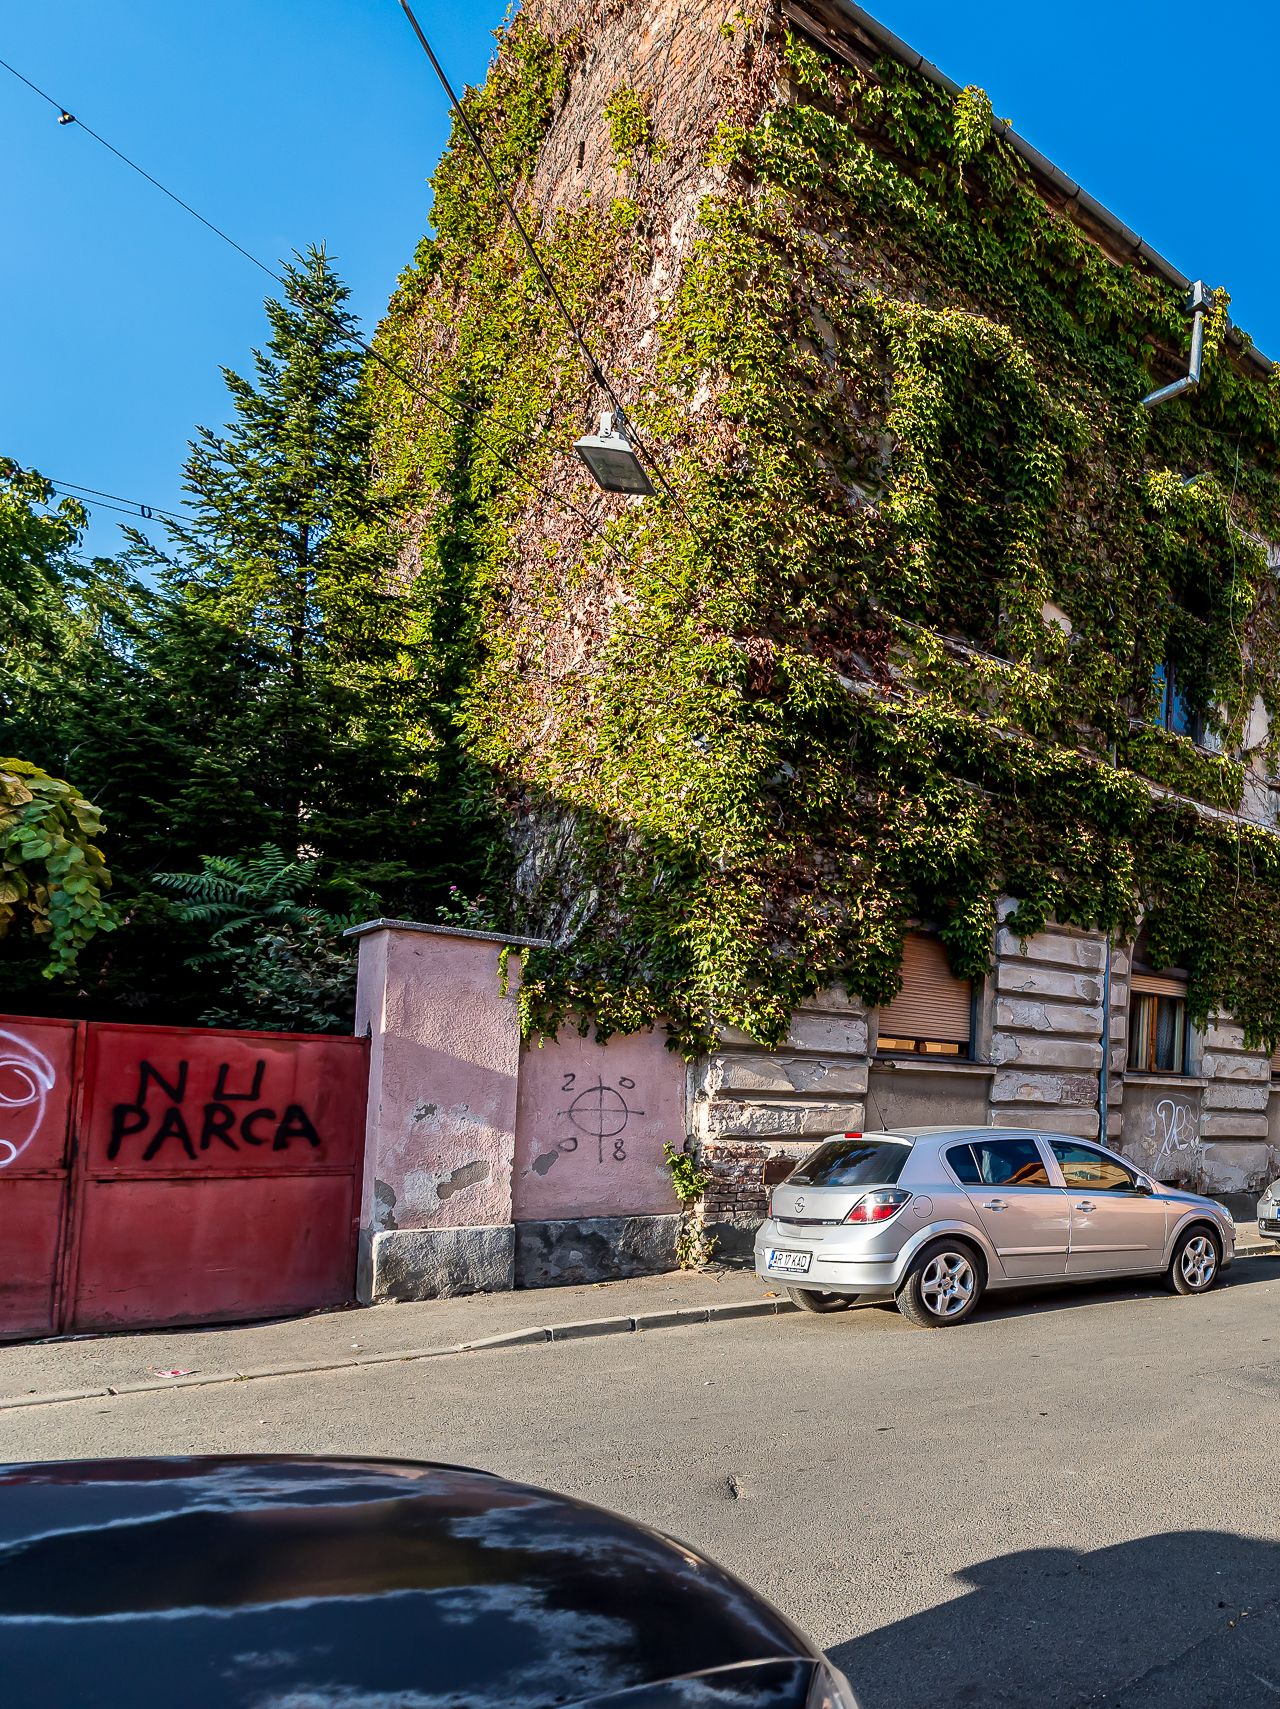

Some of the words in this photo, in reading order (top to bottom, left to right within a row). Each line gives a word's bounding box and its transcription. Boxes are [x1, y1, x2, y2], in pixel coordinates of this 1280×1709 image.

[136, 1060, 266, 1108] NU
[561, 1073, 576, 1091] 2
[107, 1102, 321, 1161] PARCA
[774, 1253, 784, 1264] AR
[785, 1254, 792, 1266] 17
[791, 1255, 807, 1268] KAD
